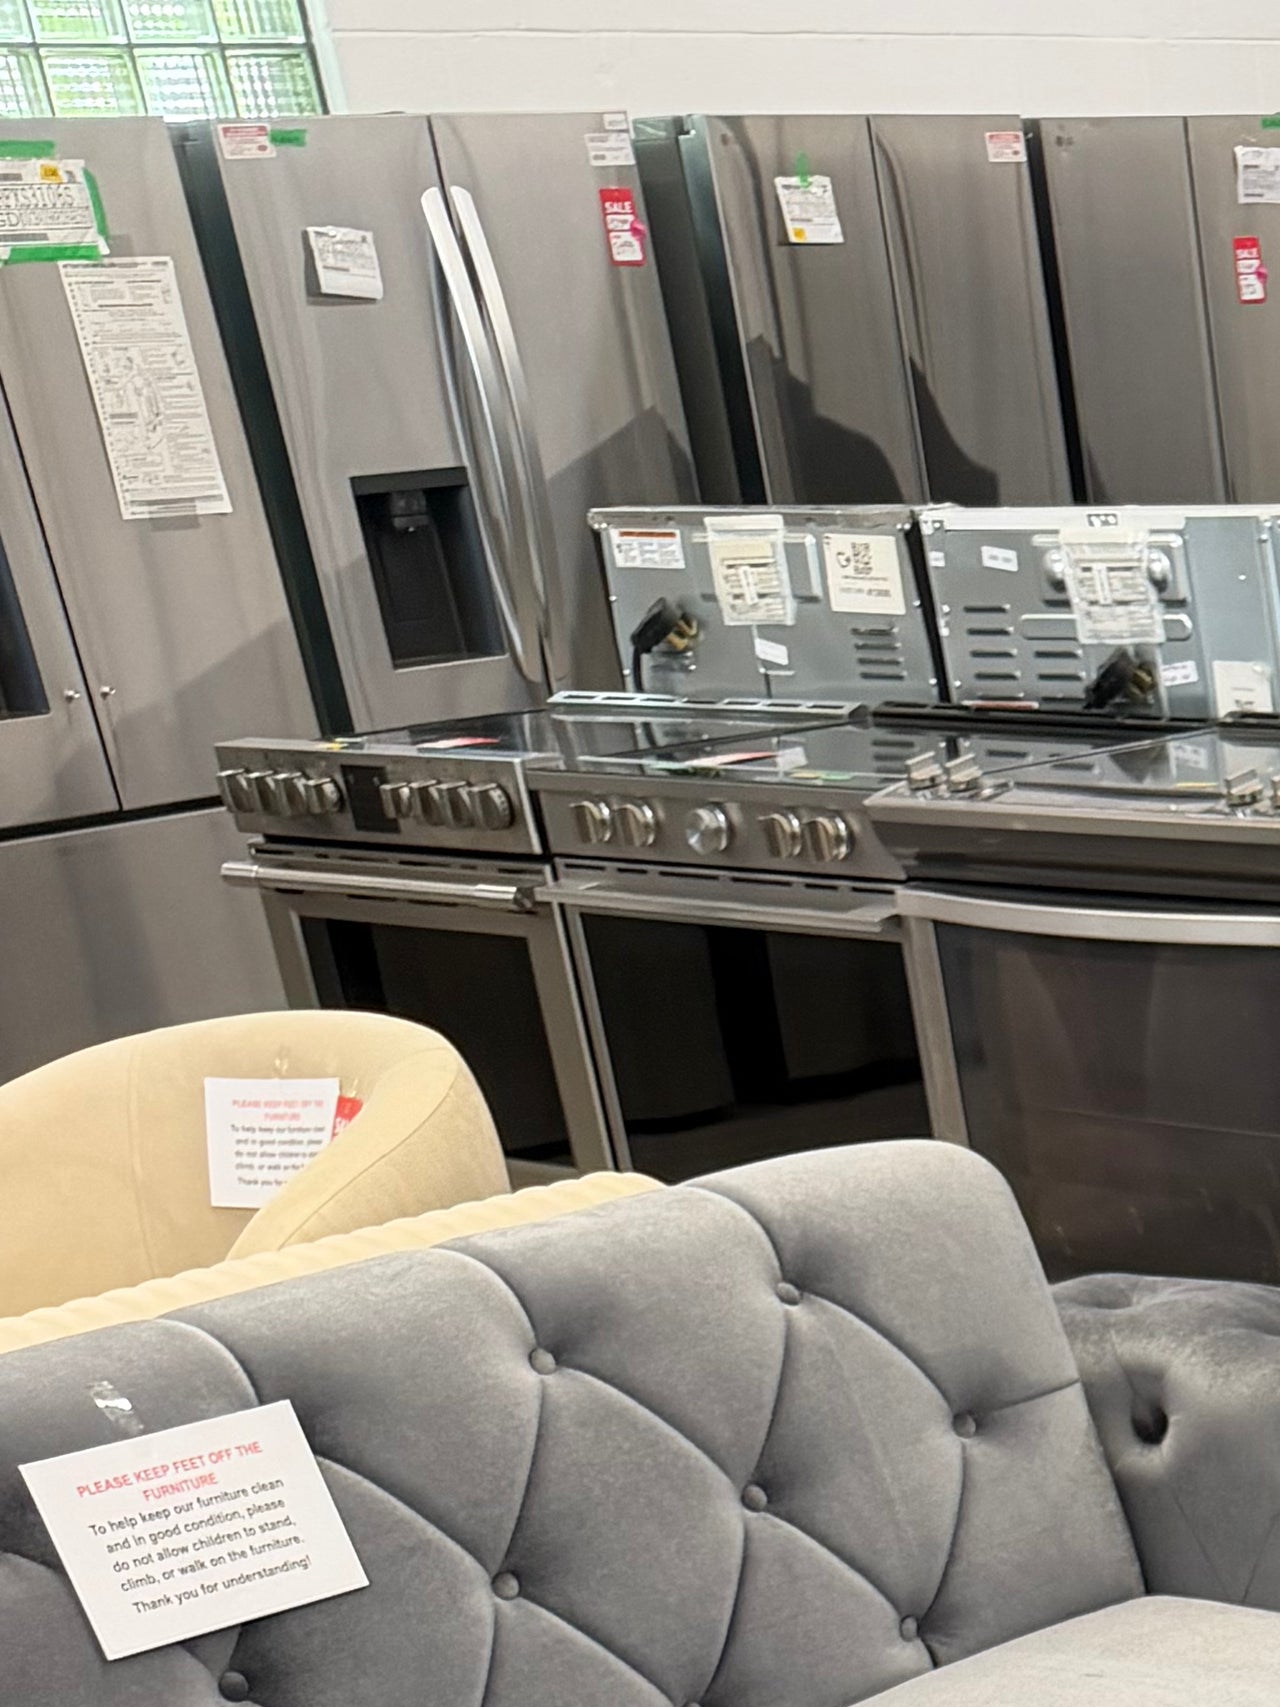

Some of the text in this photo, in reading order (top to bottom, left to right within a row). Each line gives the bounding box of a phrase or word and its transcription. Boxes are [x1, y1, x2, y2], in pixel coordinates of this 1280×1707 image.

[605, 201, 634, 213] SALE
[76, 1441, 262, 1497] PLEASE KEEP FEET OFF THE
[142, 1472, 217, 1500] FURNITURE
[88, 1479, 284, 1535] To help keep our furniture clean
[106, 1499, 284, 1553] and in good condition, please
[112, 1515, 296, 1572] do not allow children to stand,
[120, 1536, 304, 1591] climb, or walk on the furniture.
[132, 1555, 311, 1613] Thank you for understanding!
